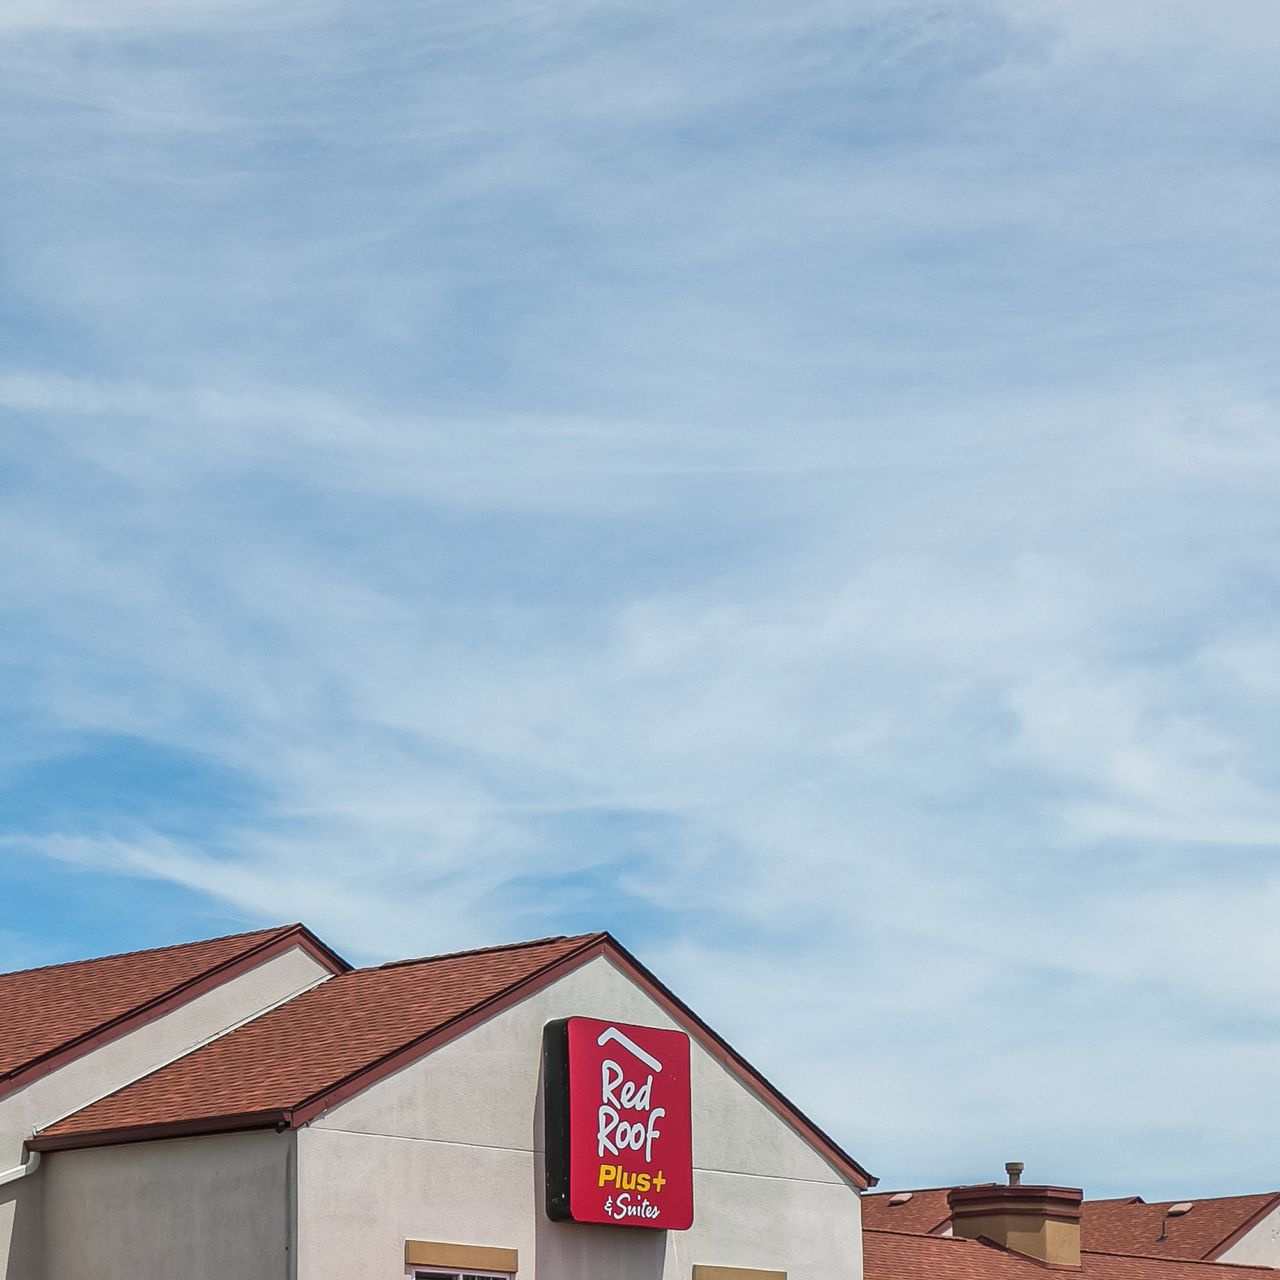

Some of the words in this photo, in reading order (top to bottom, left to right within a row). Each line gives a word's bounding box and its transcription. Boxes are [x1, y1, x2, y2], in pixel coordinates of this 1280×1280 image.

[601, 1059, 653, 1111] Red
[597, 1105, 665, 1163] Roof
[598, 1164, 667, 1194] Plus+
[604, 1197, 613, 1217] &
[613, 1193, 661, 1220] Suites
